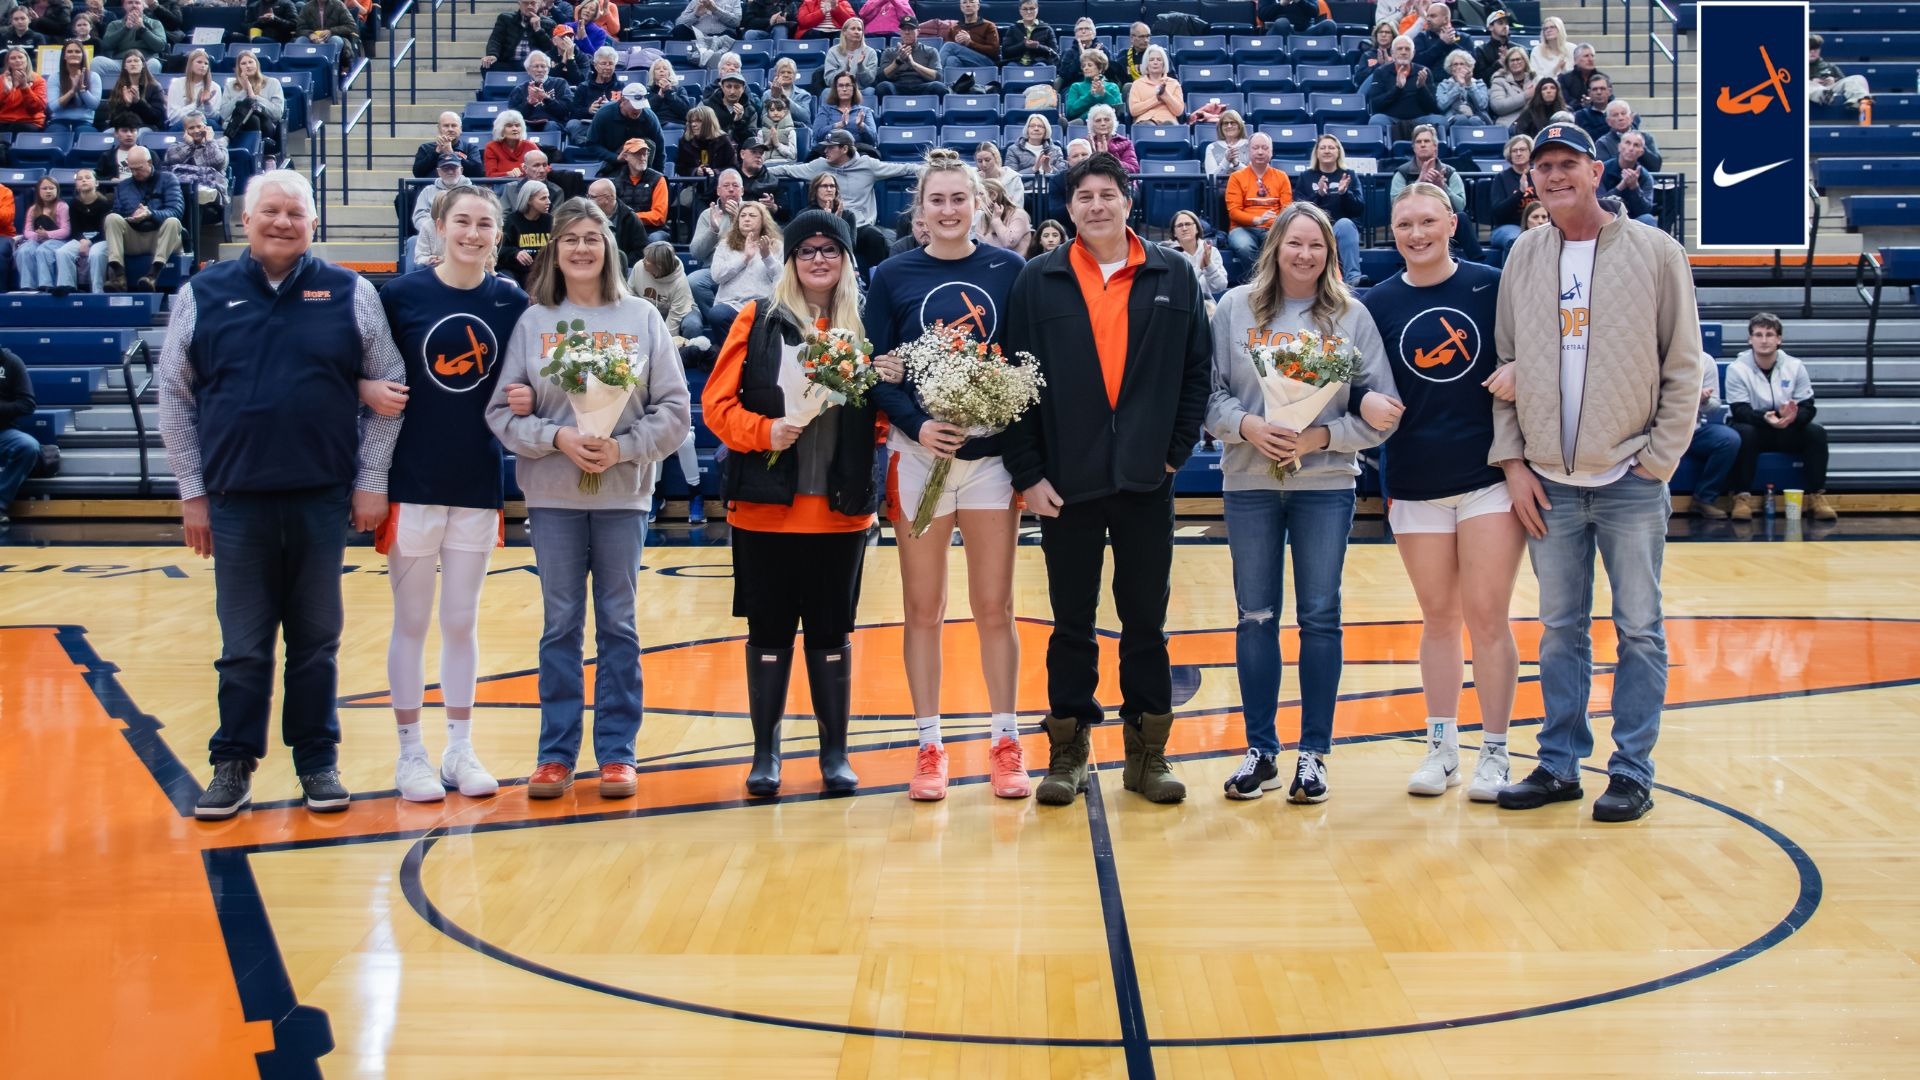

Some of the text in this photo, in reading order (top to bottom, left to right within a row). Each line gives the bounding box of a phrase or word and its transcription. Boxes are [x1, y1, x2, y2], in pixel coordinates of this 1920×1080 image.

[1548, 127, 1562, 138] H
[303, 290, 331, 298] HOPE
[540, 330, 639, 359] HPE
